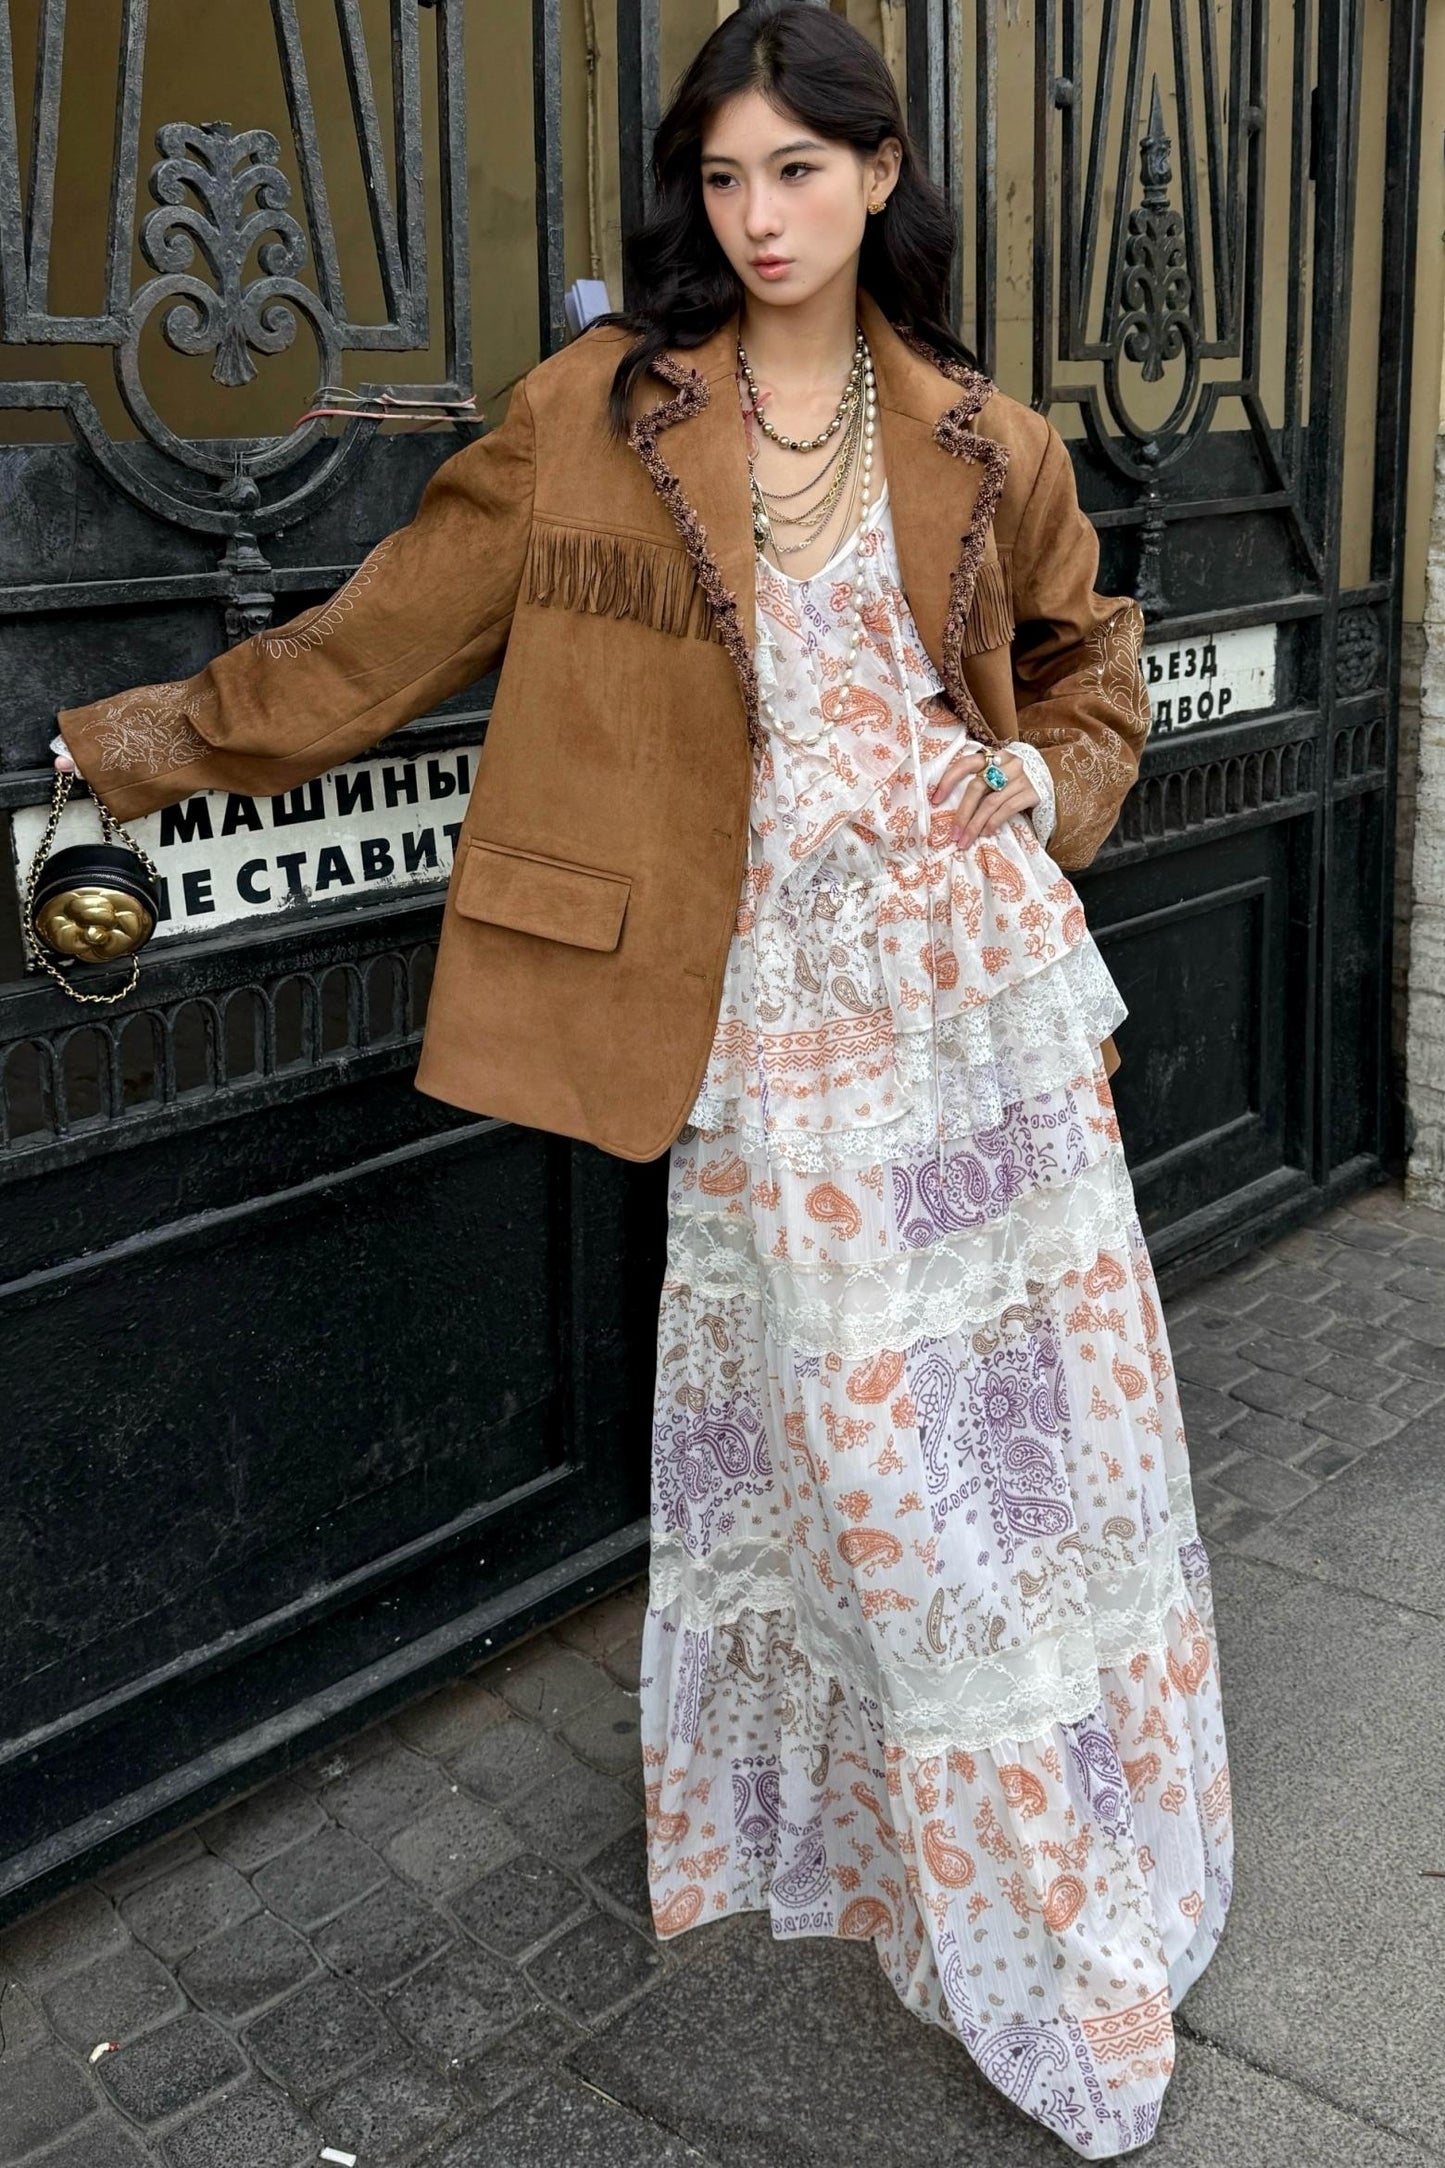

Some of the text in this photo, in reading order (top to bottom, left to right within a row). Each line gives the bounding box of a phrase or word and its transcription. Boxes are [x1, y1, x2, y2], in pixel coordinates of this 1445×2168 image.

[1138, 645, 1217, 685] ЪЕЗД
[1153, 687, 1232, 732] ДВОР
[160, 754, 471, 847] МАШИНЫ
